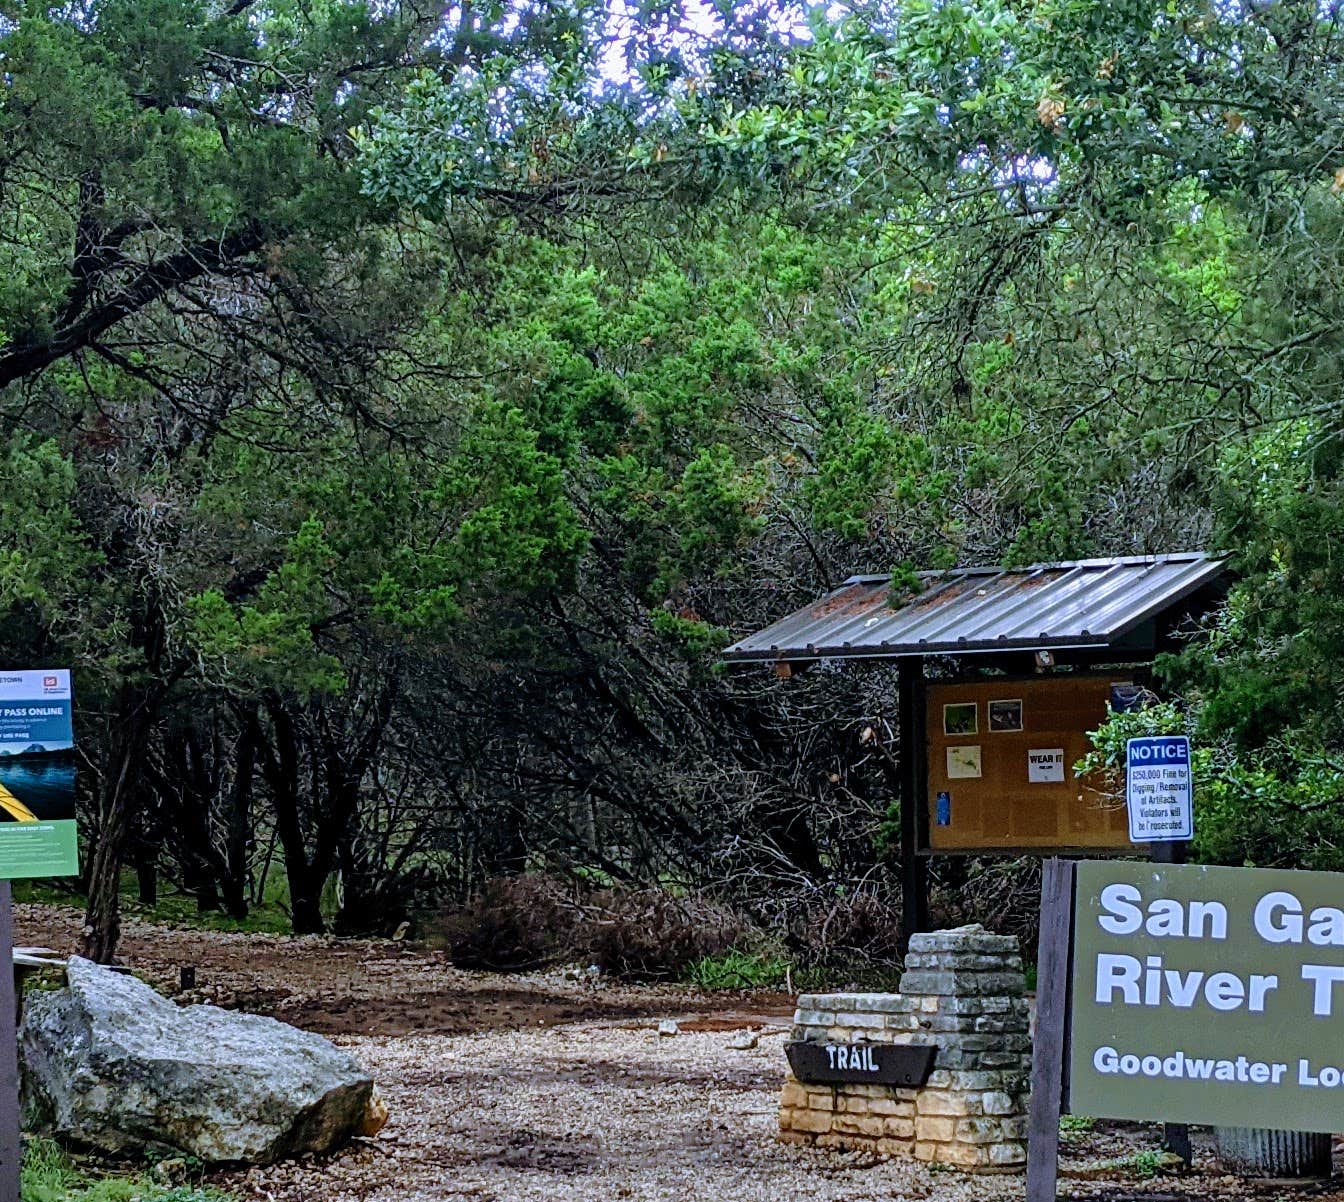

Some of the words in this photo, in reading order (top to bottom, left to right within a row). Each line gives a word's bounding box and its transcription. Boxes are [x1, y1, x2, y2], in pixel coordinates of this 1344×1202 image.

[4, 708, 27, 717] PASS
[27, 707, 63, 716] ONLINE
[1131, 744, 1187, 760] NOTICE
[1030, 755, 1053, 763] WEAR
[1132, 769, 1160, 780] $250,000
[1162, 769, 1177, 779] Fine
[1178, 768, 1188, 778] for
[1148, 795, 1177, 805] Artifacts.
[1140, 808, 1168, 818] Violators
[1170, 807, 1181, 817] will
[1138, 822, 1145, 831] be
[1097, 883, 1228, 940] San
[1094, 953, 1278, 1012] River
[825, 1045, 880, 1071] TRAIL
[1092, 1045, 1287, 1084] Goodwater
